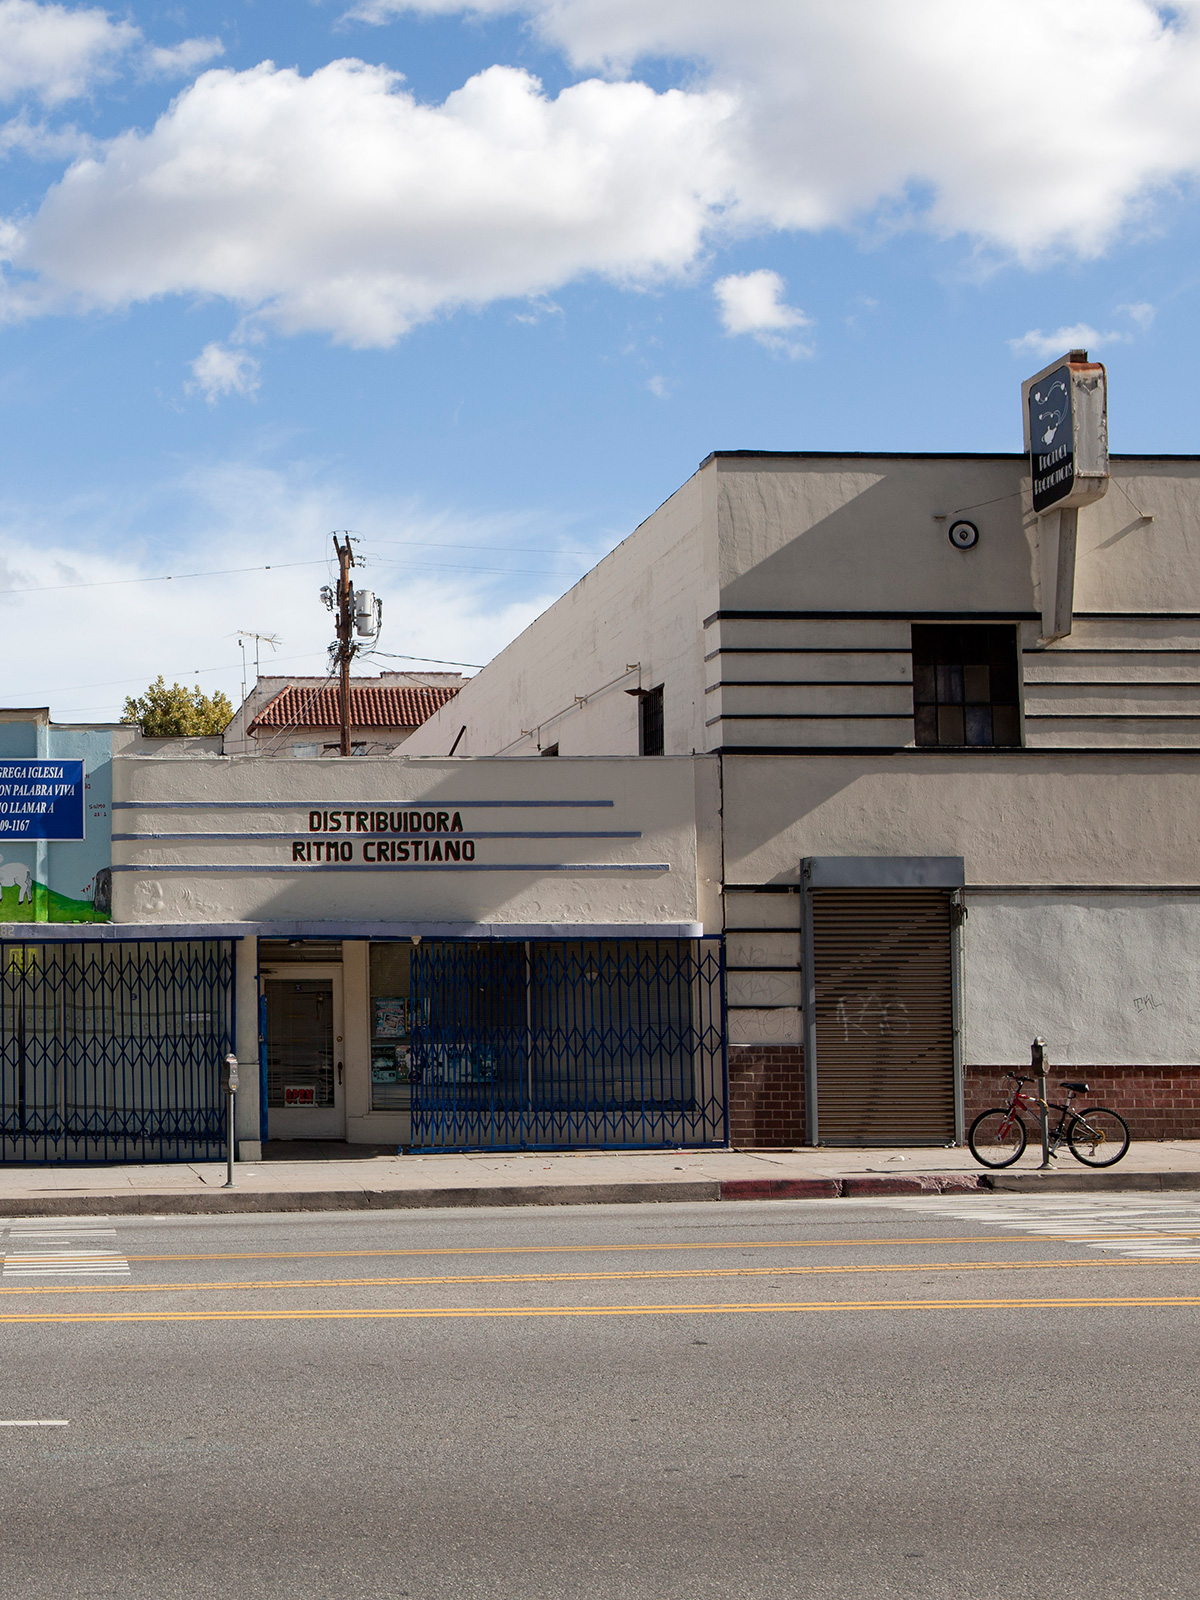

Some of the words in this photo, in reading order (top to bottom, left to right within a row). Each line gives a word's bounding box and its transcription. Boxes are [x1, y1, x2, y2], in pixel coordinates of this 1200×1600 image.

[27, 767, 64, 778] IGLESIA
[13, 785, 53, 796] PALABRA
[54, 785, 75, 796] VIVA
[9, 802, 47, 814] LLAMAR
[47, 802, 54, 813] A
[309, 811, 463, 832] DISTRIBUIDORA
[292, 841, 353, 862] RITMO
[363, 840, 476, 862] CRISTIANO
[286, 1089, 314, 1104] OPEN
